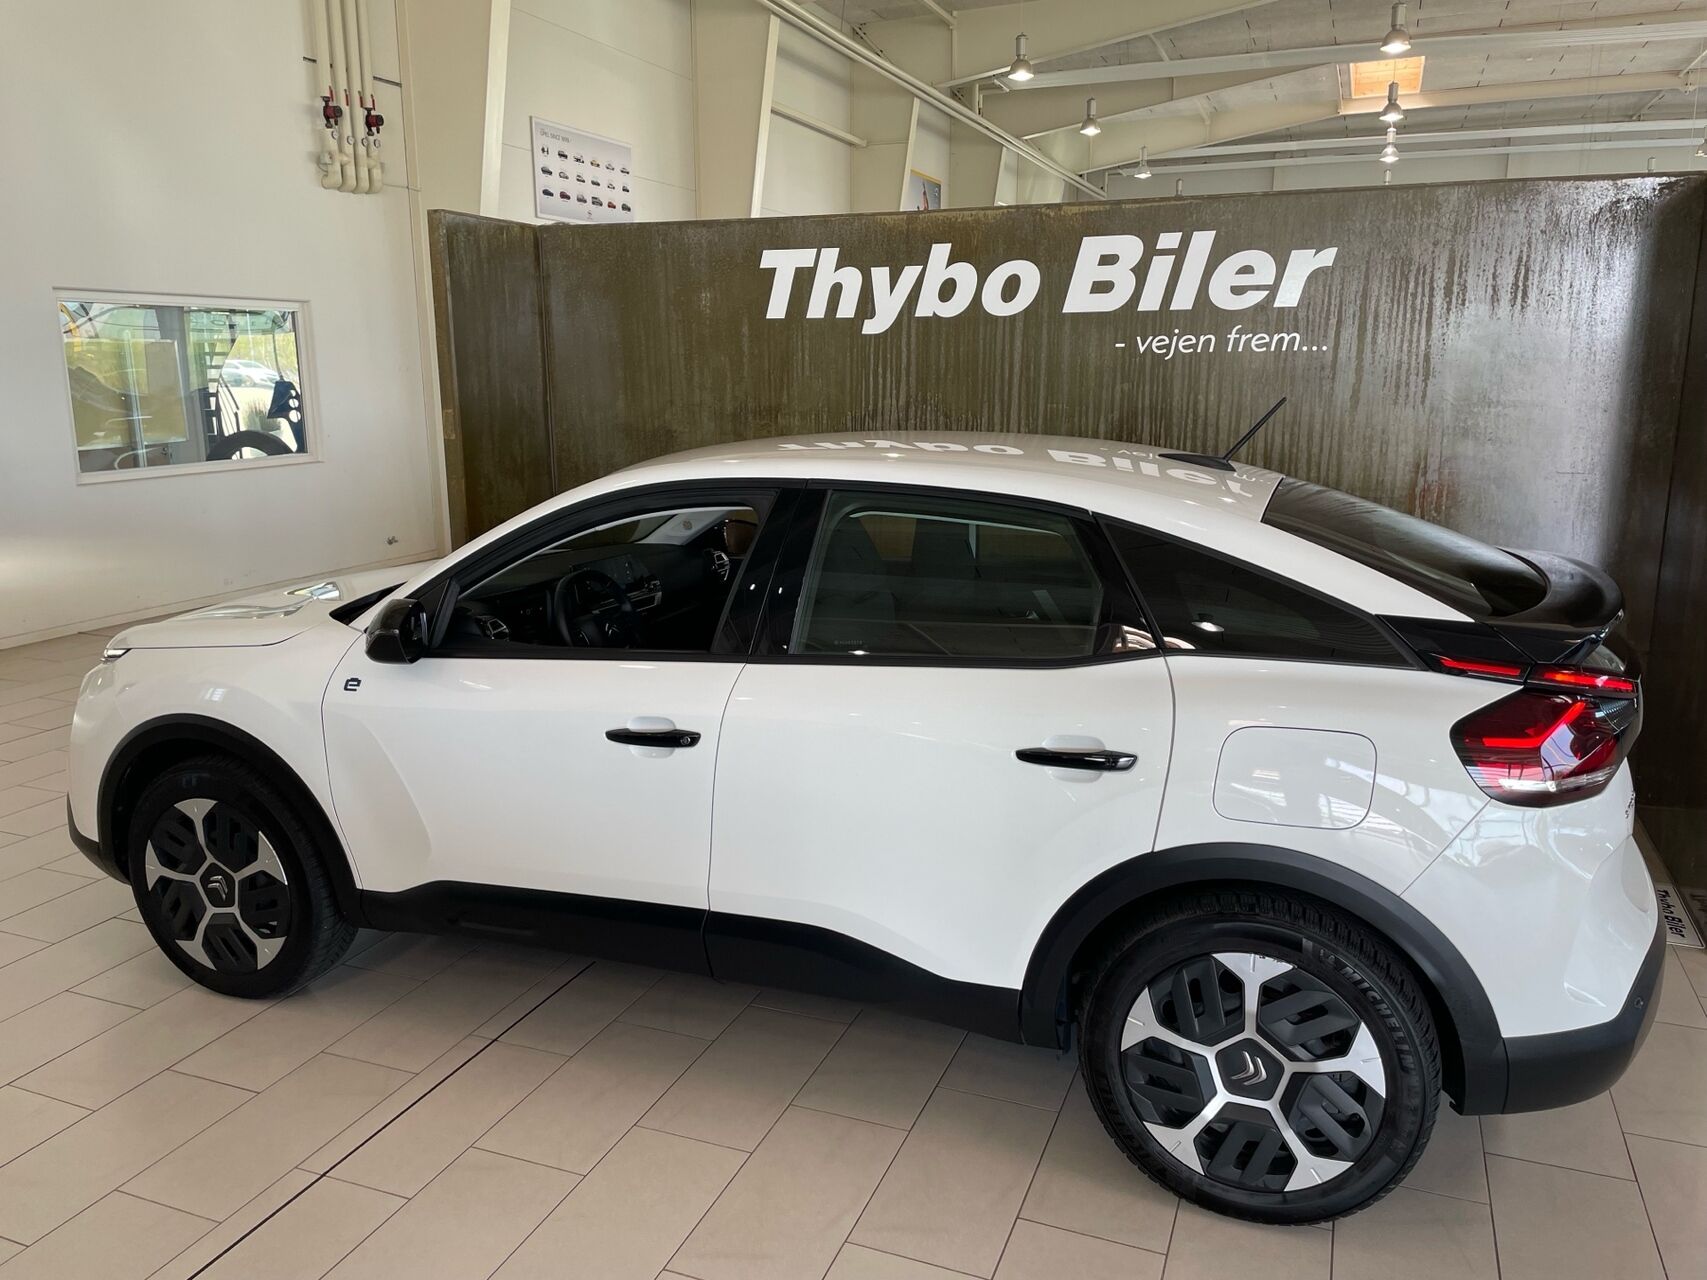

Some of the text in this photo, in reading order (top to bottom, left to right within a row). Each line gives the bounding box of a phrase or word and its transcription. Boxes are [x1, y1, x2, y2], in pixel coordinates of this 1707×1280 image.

[760, 231, 1338, 334] Thybo Biler
[1137, 329, 1215, 359] vejen
[1227, 325, 1327, 351] frem...
[1664, 914, 1687, 939] Biler
[1340, 966, 1415, 1074] MICHELIN
